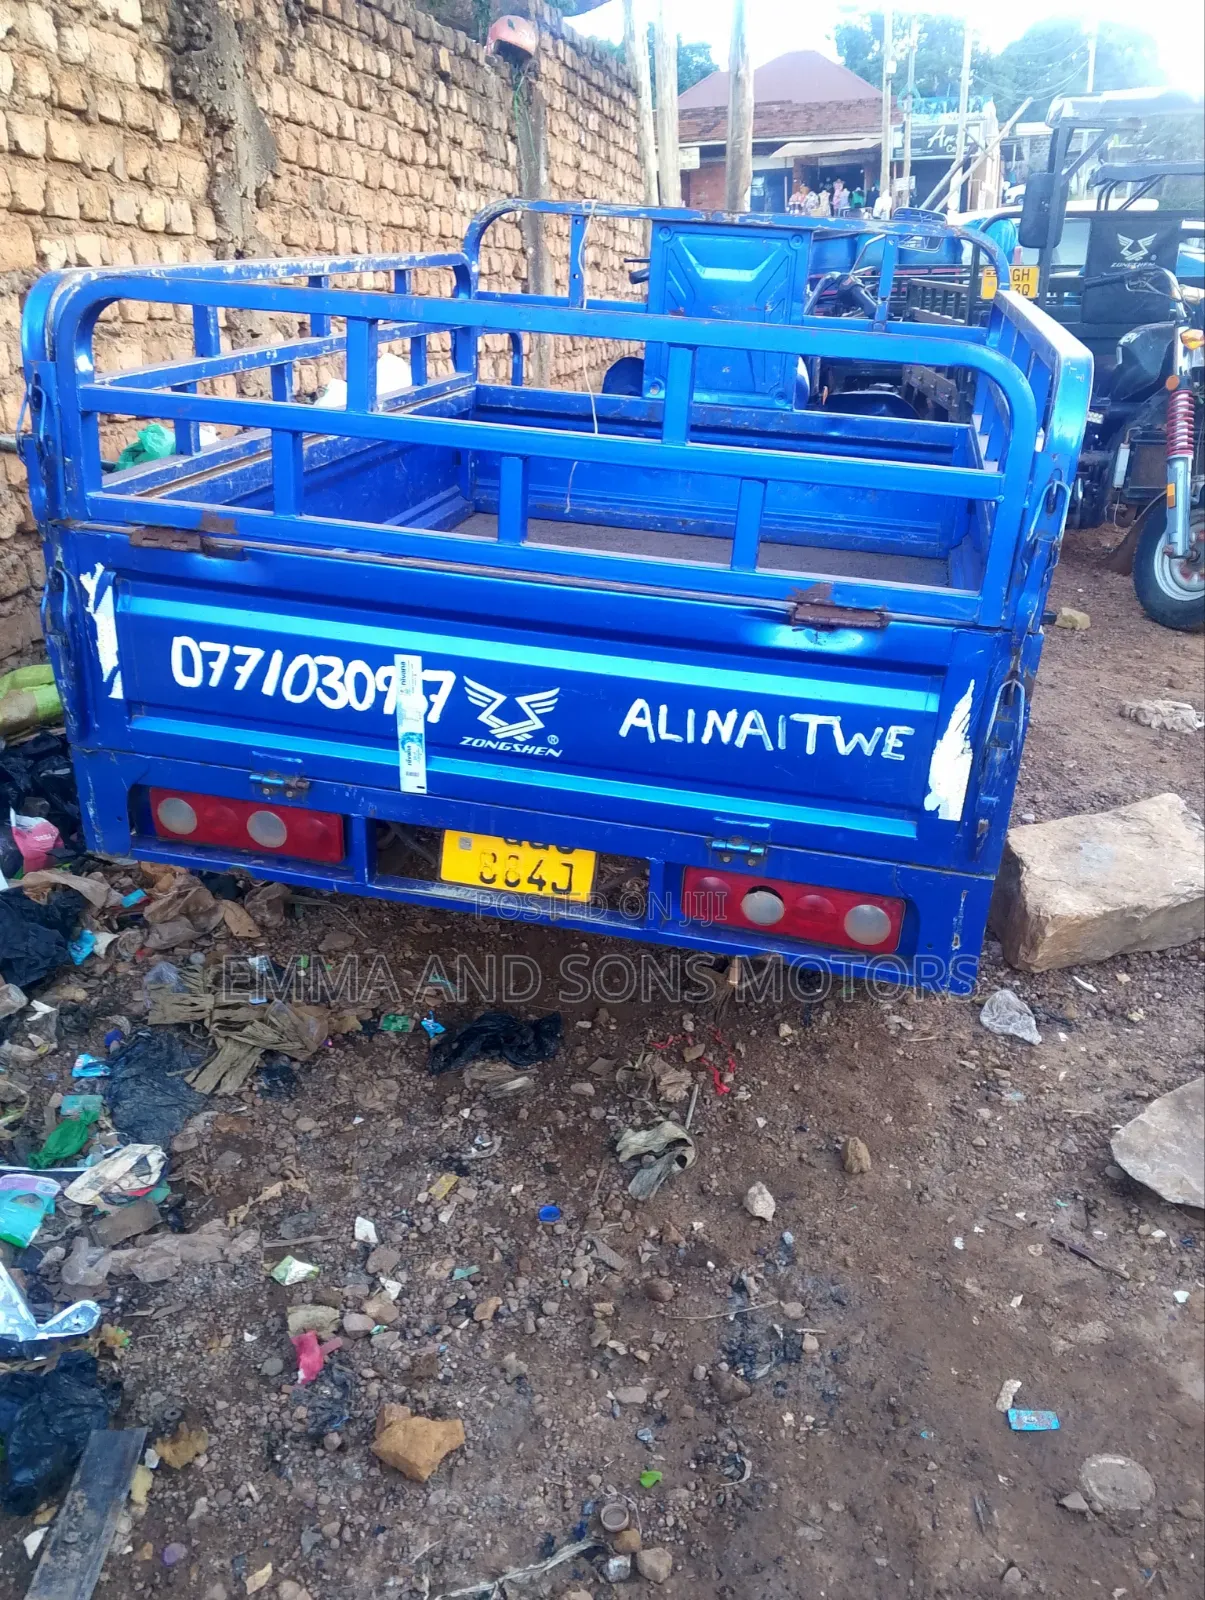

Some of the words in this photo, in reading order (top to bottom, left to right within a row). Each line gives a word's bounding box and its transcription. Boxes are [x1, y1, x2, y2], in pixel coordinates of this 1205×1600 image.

[171, 635, 456, 724] 077103097
[459, 736, 563, 758] ZONGSHEN
[619, 697, 915, 761] ALINAITWE
